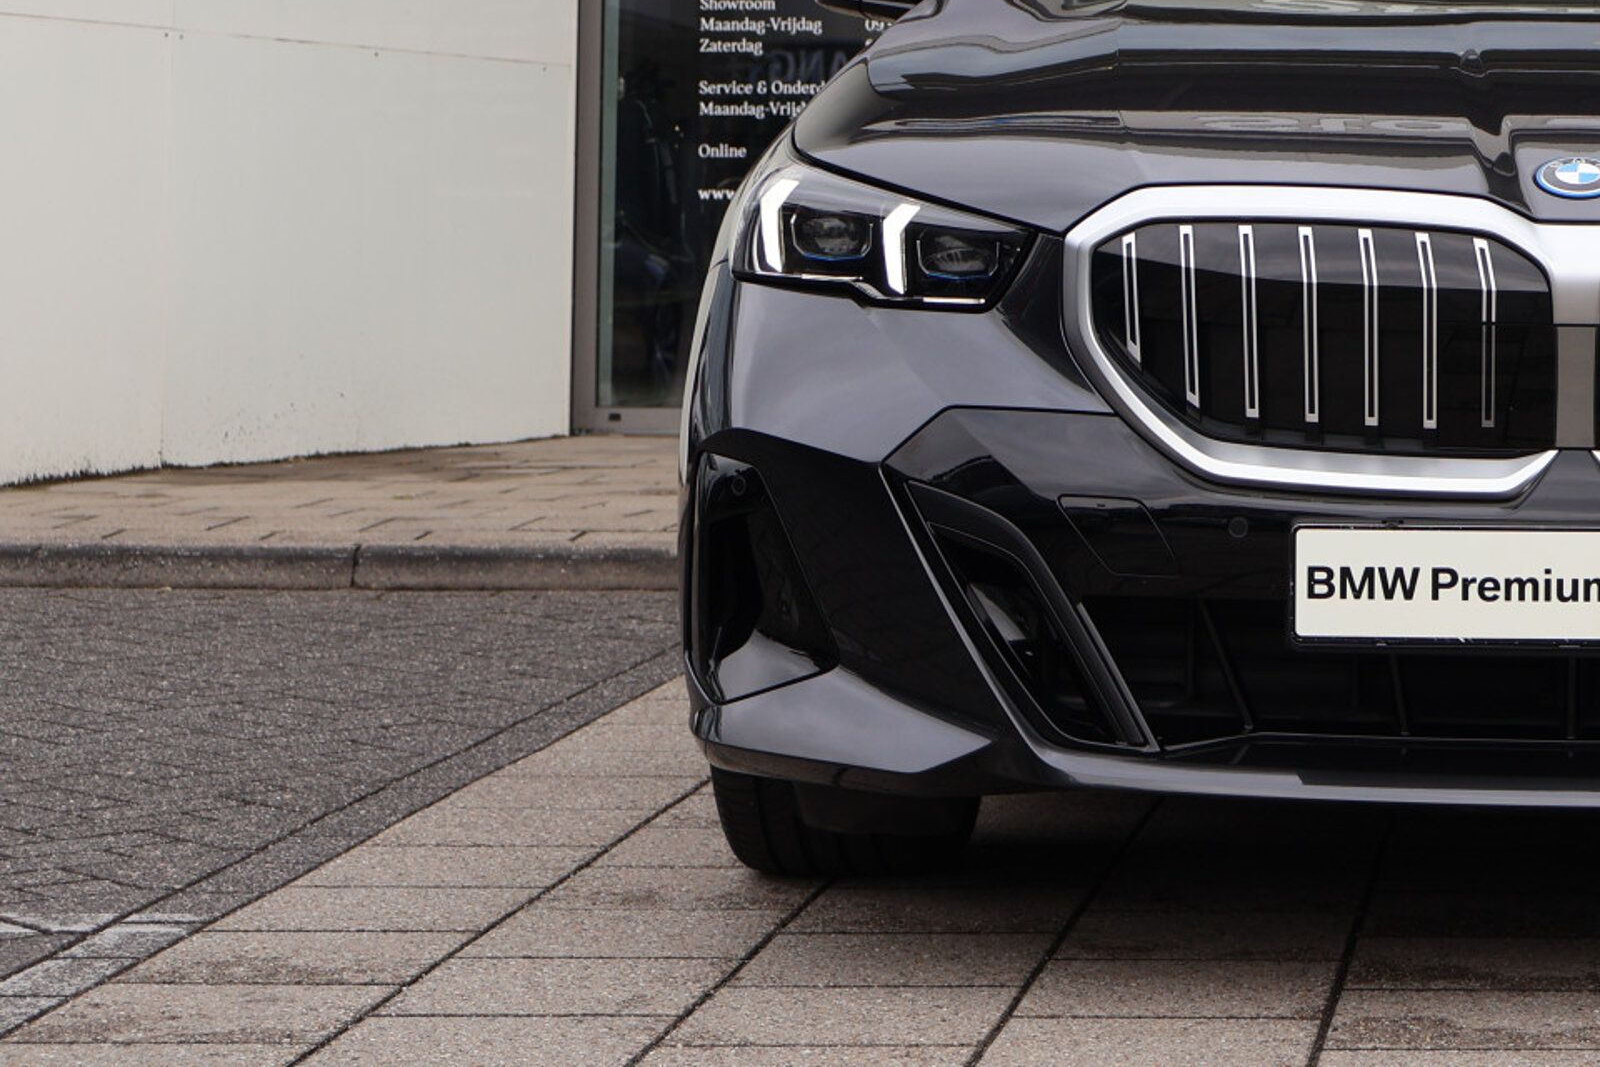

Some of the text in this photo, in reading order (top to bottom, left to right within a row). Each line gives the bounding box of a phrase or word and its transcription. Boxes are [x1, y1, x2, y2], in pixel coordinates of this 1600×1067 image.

[700, 17, 822, 34] Maandag-Vrijdag
[700, 38, 763, 56] Zaterdag
[699, 81, 753, 95] Service
[756, 81, 767, 95] &
[698, 143, 747, 158] Online
[1306, 566, 1421, 601] BMW
